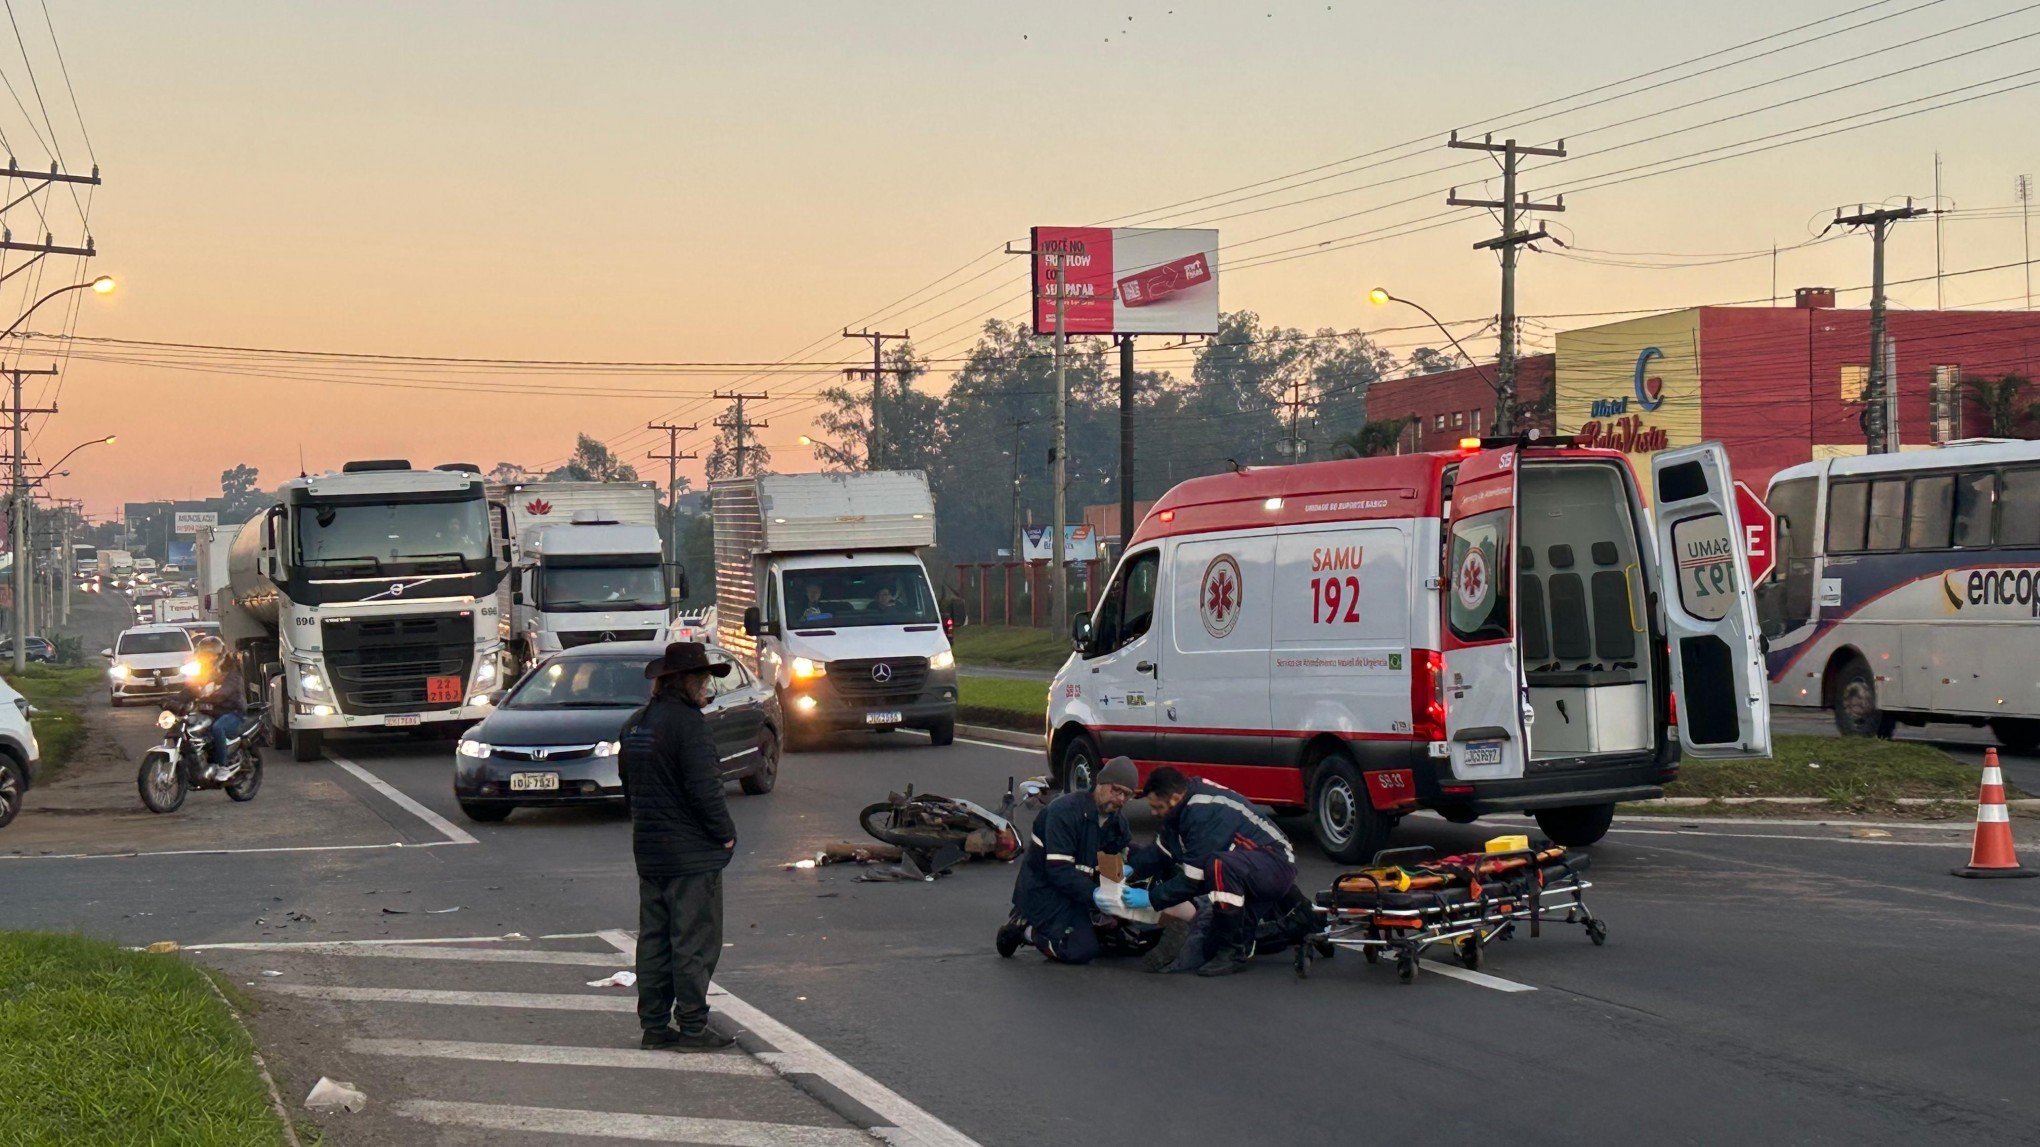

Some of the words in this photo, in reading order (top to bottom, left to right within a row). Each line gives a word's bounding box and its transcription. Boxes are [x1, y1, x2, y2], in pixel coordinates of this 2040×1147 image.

[1066, 254, 1091, 267] FLOW
[1312, 546, 1363, 572] SAMU
[1311, 576, 1360, 624] 192
